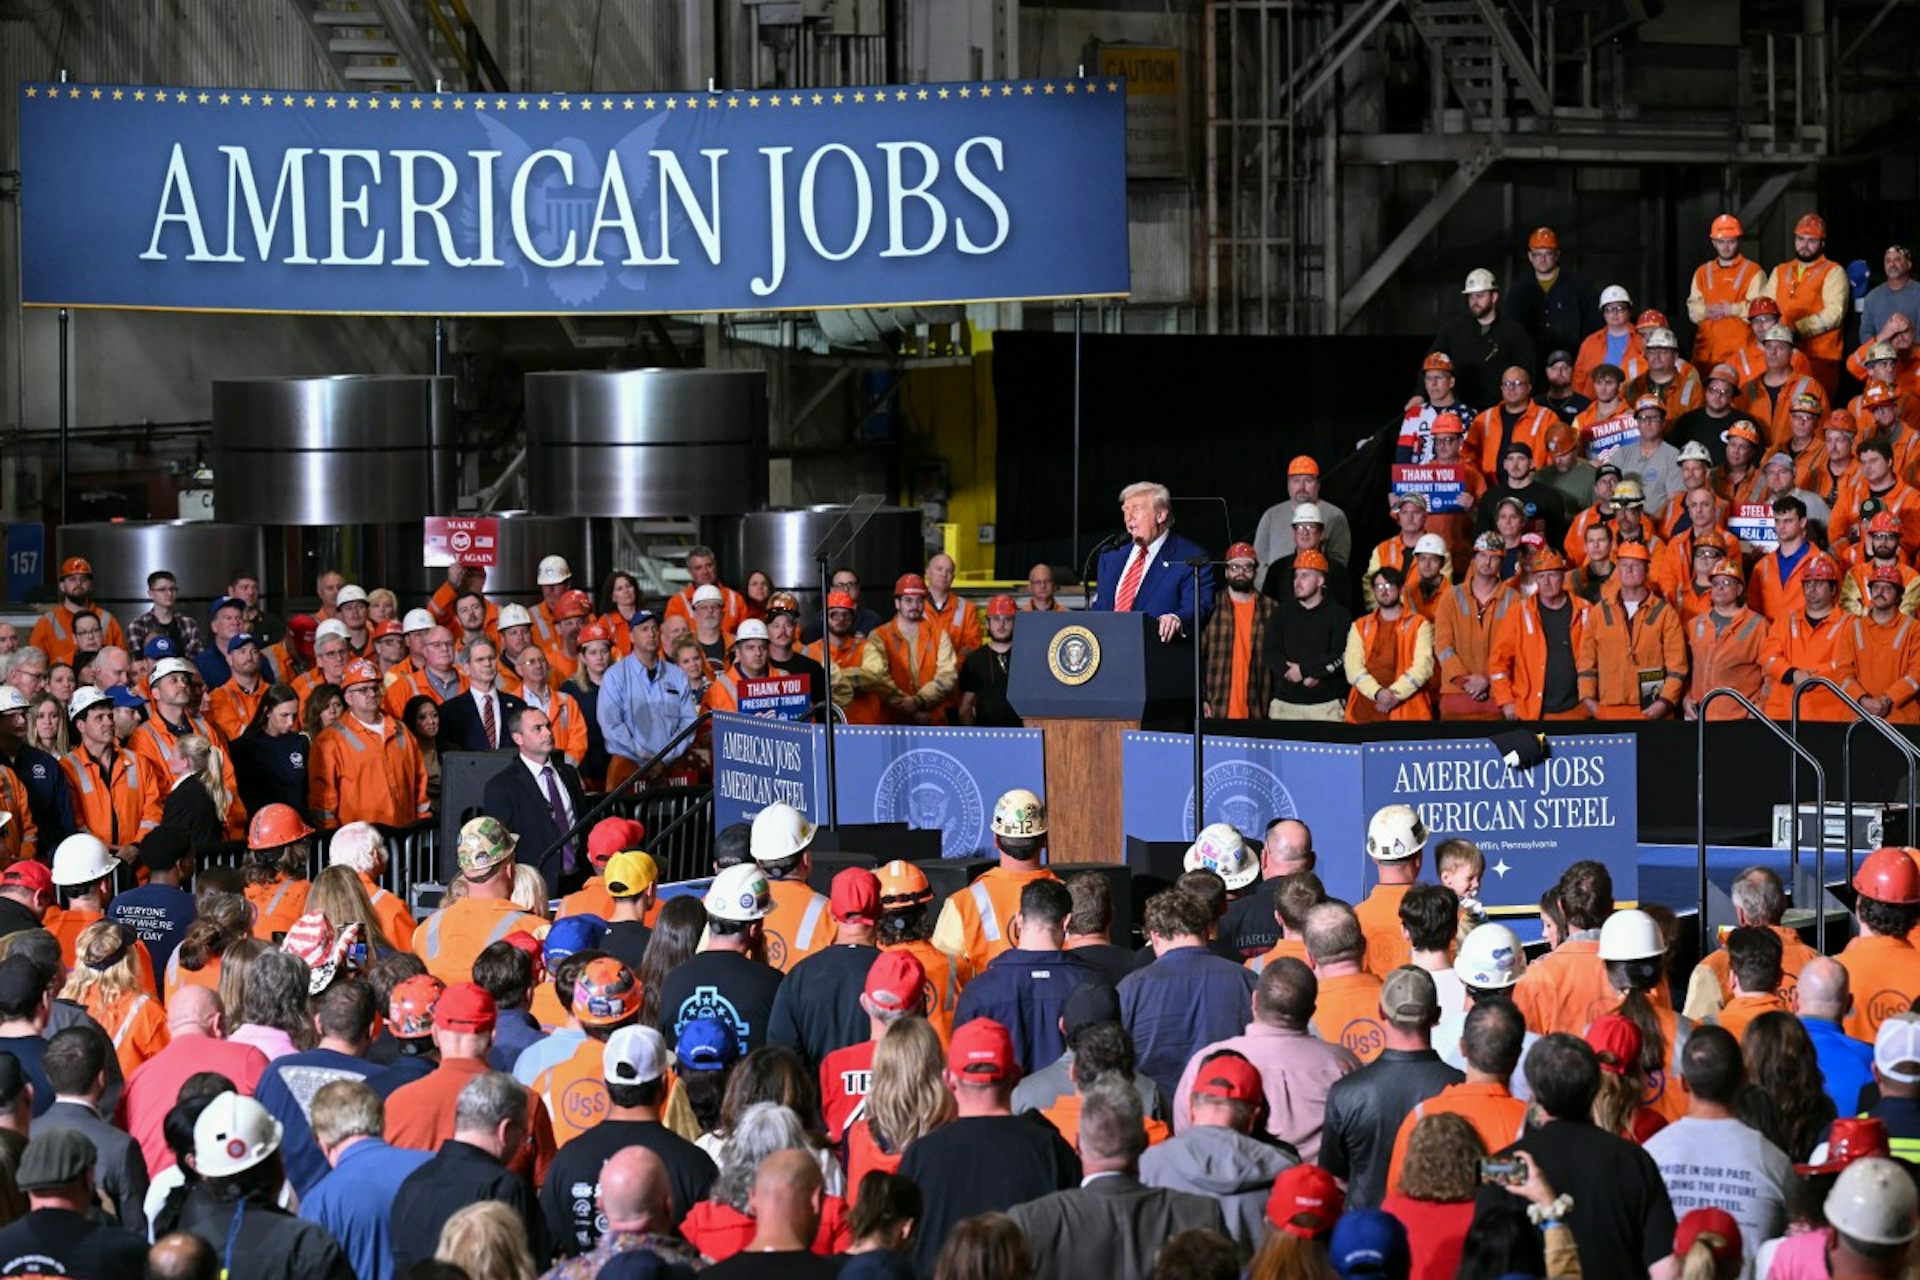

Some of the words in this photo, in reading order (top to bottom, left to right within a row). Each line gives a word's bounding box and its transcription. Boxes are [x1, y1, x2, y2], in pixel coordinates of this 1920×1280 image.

[139, 143, 729, 268] AMERICAN
[750, 136, 1010, 296] JOBS
[1592, 420, 1621, 438] THANK
[1401, 469, 1434, 481] THANK
[1435, 469, 1455, 481] YOU
[1396, 483, 1433, 492] PRESIDENT
[1740, 504, 1765, 517] STEEL
[447, 521, 476, 530] MAKE
[11, 552, 38, 575] 157
[463, 554, 492, 562] AGAIN
[747, 682, 779, 697] THANK
[782, 680, 801, 694] YOU
[742, 697, 779, 709] PRESIDENT
[723, 731, 774, 766] AMERICAN
[775, 740, 801, 775] JOBS
[1393, 759, 1534, 793] AMERICAN
[1540, 756, 1605, 795] JOBS
[720, 770, 772, 805] AMERICAN
[773, 778, 807, 812] STEEL
[1405, 799, 1528, 833] ERICAN
[1534, 796, 1616, 829] STEEL
[1501, 839, 1558, 850] Pennsylvania
[116, 905, 167, 918] EVERYONE
[120, 918, 174, 931] ERYWHERE
[143, 931, 163, 941] DAY
[1689, 1165, 1700, 1176] IN
[1703, 1166, 1723, 1177] OUR
[1699, 1182, 1714, 1193] THE
[1699, 1197, 1710, 1207] BY
